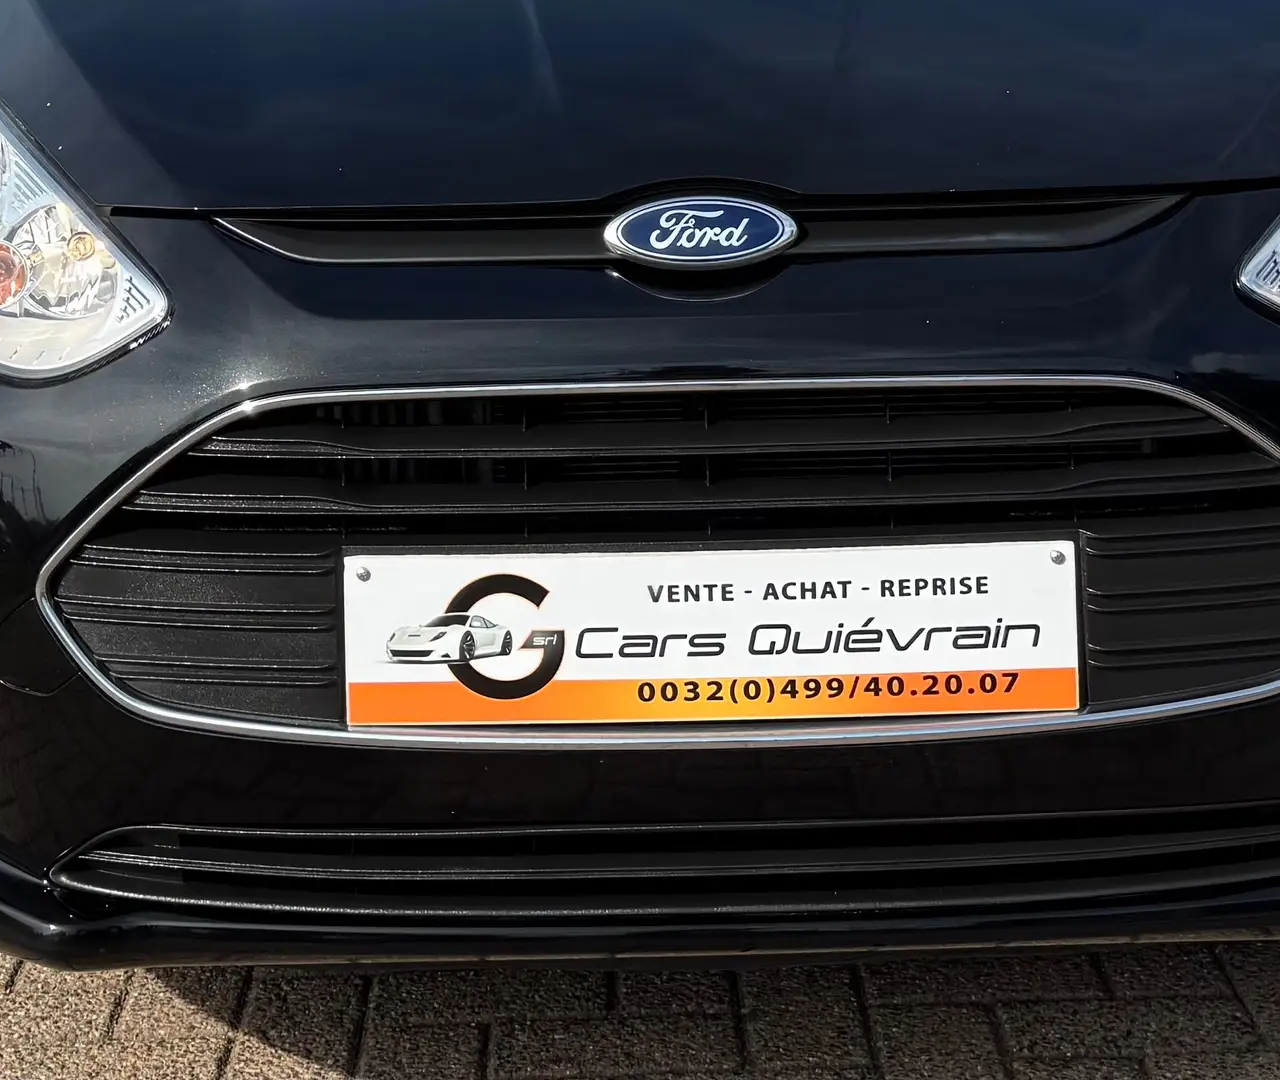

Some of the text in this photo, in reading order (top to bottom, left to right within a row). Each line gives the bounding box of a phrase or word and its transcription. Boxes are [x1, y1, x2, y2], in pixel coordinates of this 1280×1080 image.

[649, 209, 750, 250] Ford
[647, 583, 735, 603] VENTE
[762, 580, 852, 601] ACHAT
[880, 576, 989, 597] REPRISE
[532, 633, 558, 646] srl
[575, 616, 1041, 659] Cars Quiévrain
[637, 672, 1020, 704] 0032(0)499/40.20.07
